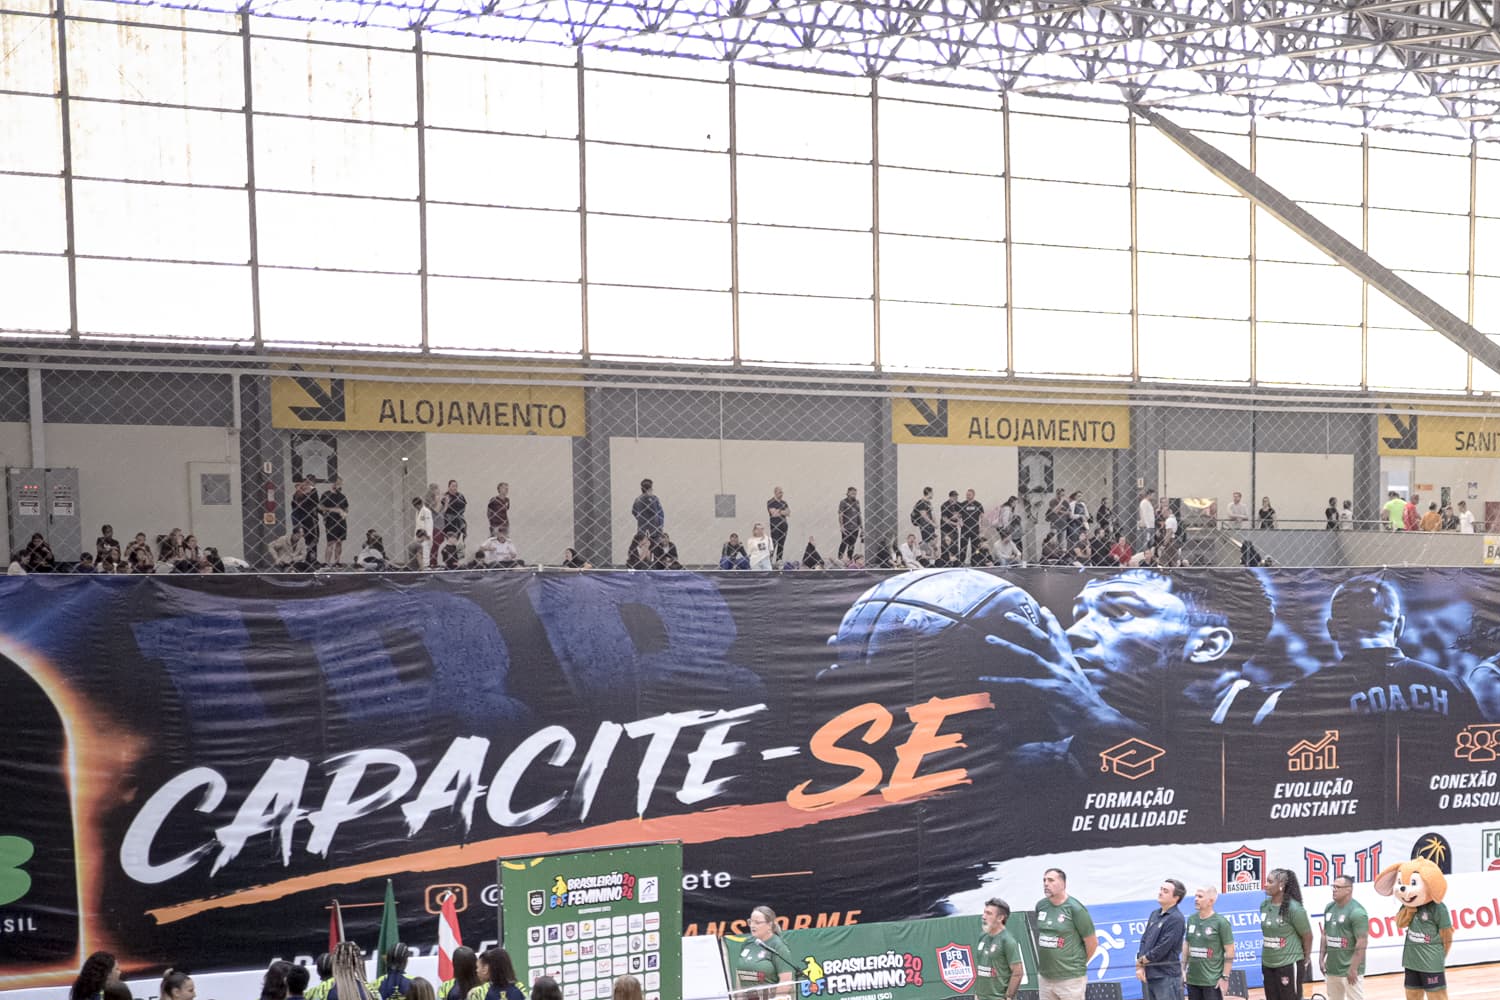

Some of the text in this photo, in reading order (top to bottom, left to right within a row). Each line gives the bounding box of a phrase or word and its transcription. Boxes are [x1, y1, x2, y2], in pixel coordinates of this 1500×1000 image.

[379, 397, 567, 429] ALOJAMENTO
[967, 416, 1116, 443] ALOJAMENTO
[1350, 684, 1449, 715] COACH
[1274, 778, 1354, 799] EVOLUÇÃO
[1429, 771, 1498, 791] CONEXÃO
[1084, 787, 1175, 810] FORMAÇÃO
[1270, 799, 1359, 819] CONSTANTE
[1439, 794, 1450, 809] O
[1072, 809, 1189, 832] DE QUALIDADE
[1233, 858, 1254, 872] BFB
[567, 886, 623, 906] FEMININO
[1227, 882, 1261, 893] BASQUETE
[0, 917, 38, 933] SIL
[823, 951, 904, 975] BRASILEIRÃO
[827, 969, 907, 995] FEMININO
